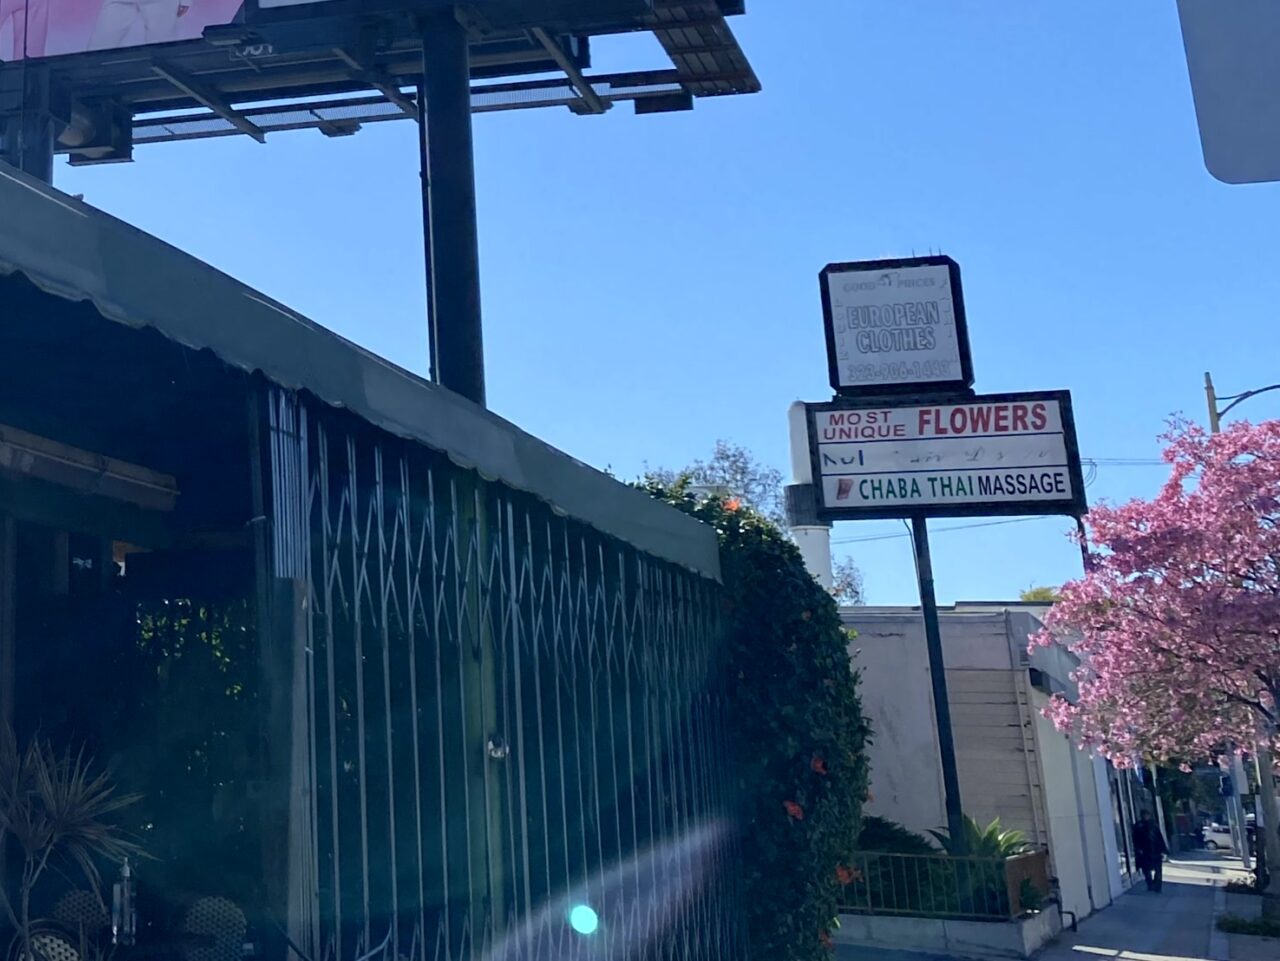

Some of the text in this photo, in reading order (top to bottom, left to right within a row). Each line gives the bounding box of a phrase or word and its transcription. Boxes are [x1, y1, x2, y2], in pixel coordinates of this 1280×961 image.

[846, 301, 940, 329] EUROPEAN
[856, 326, 936, 354] CLOTHES
[824, 424, 906, 440] UNIQUE
[829, 404, 1047, 436] MOST FLOWERS
[859, 473, 1066, 500] CHABA THAI MASSAGE
